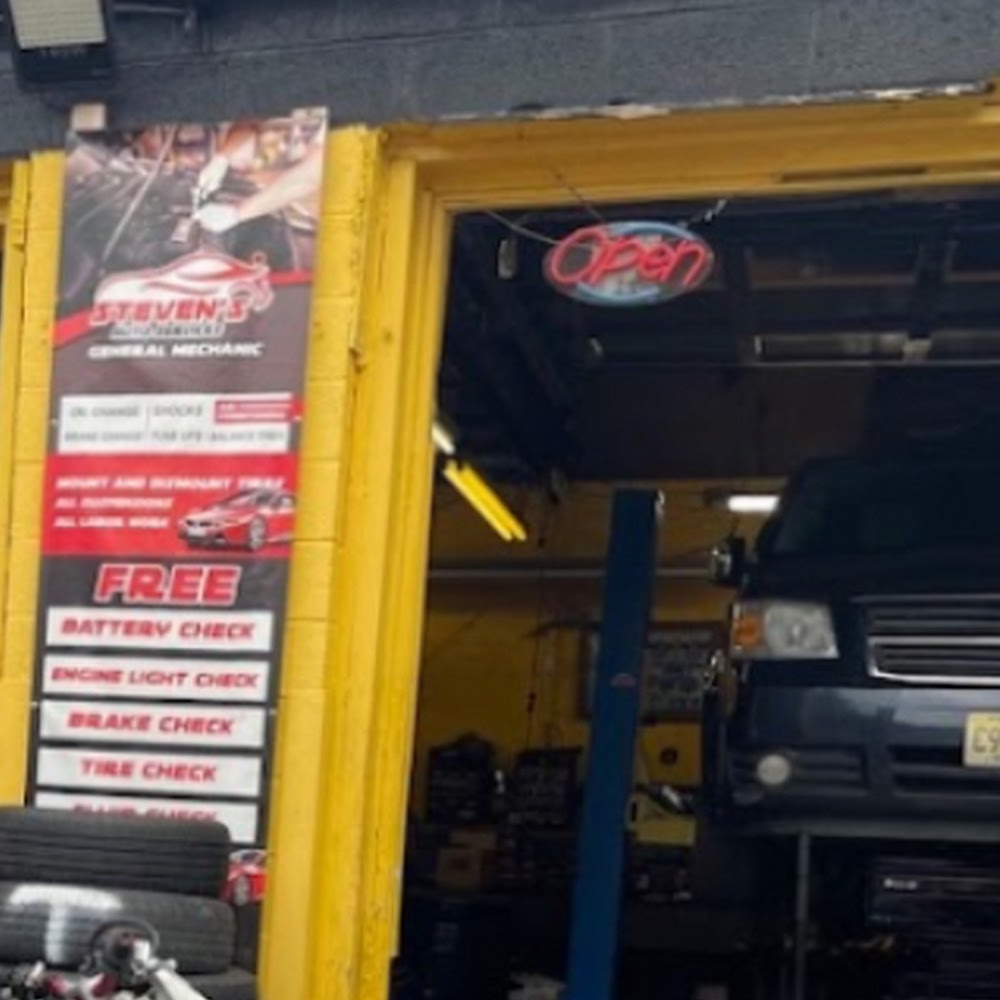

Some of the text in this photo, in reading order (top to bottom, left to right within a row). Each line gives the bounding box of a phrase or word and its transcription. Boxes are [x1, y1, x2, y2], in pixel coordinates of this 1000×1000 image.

[550, 224, 705, 287] Open
[91, 299, 247, 325] STEVEN'S
[88, 342, 264, 359] GENERAL MECHANIC
[94, 563, 241, 605] FREE
[61, 618, 255, 641] BATTERY CHECK
[51, 666, 260, 690] ENGINE LIGHT CHECK
[67, 711, 235, 736] BRAKE CHECK
[80, 758, 217, 783] TIRE CHECK
